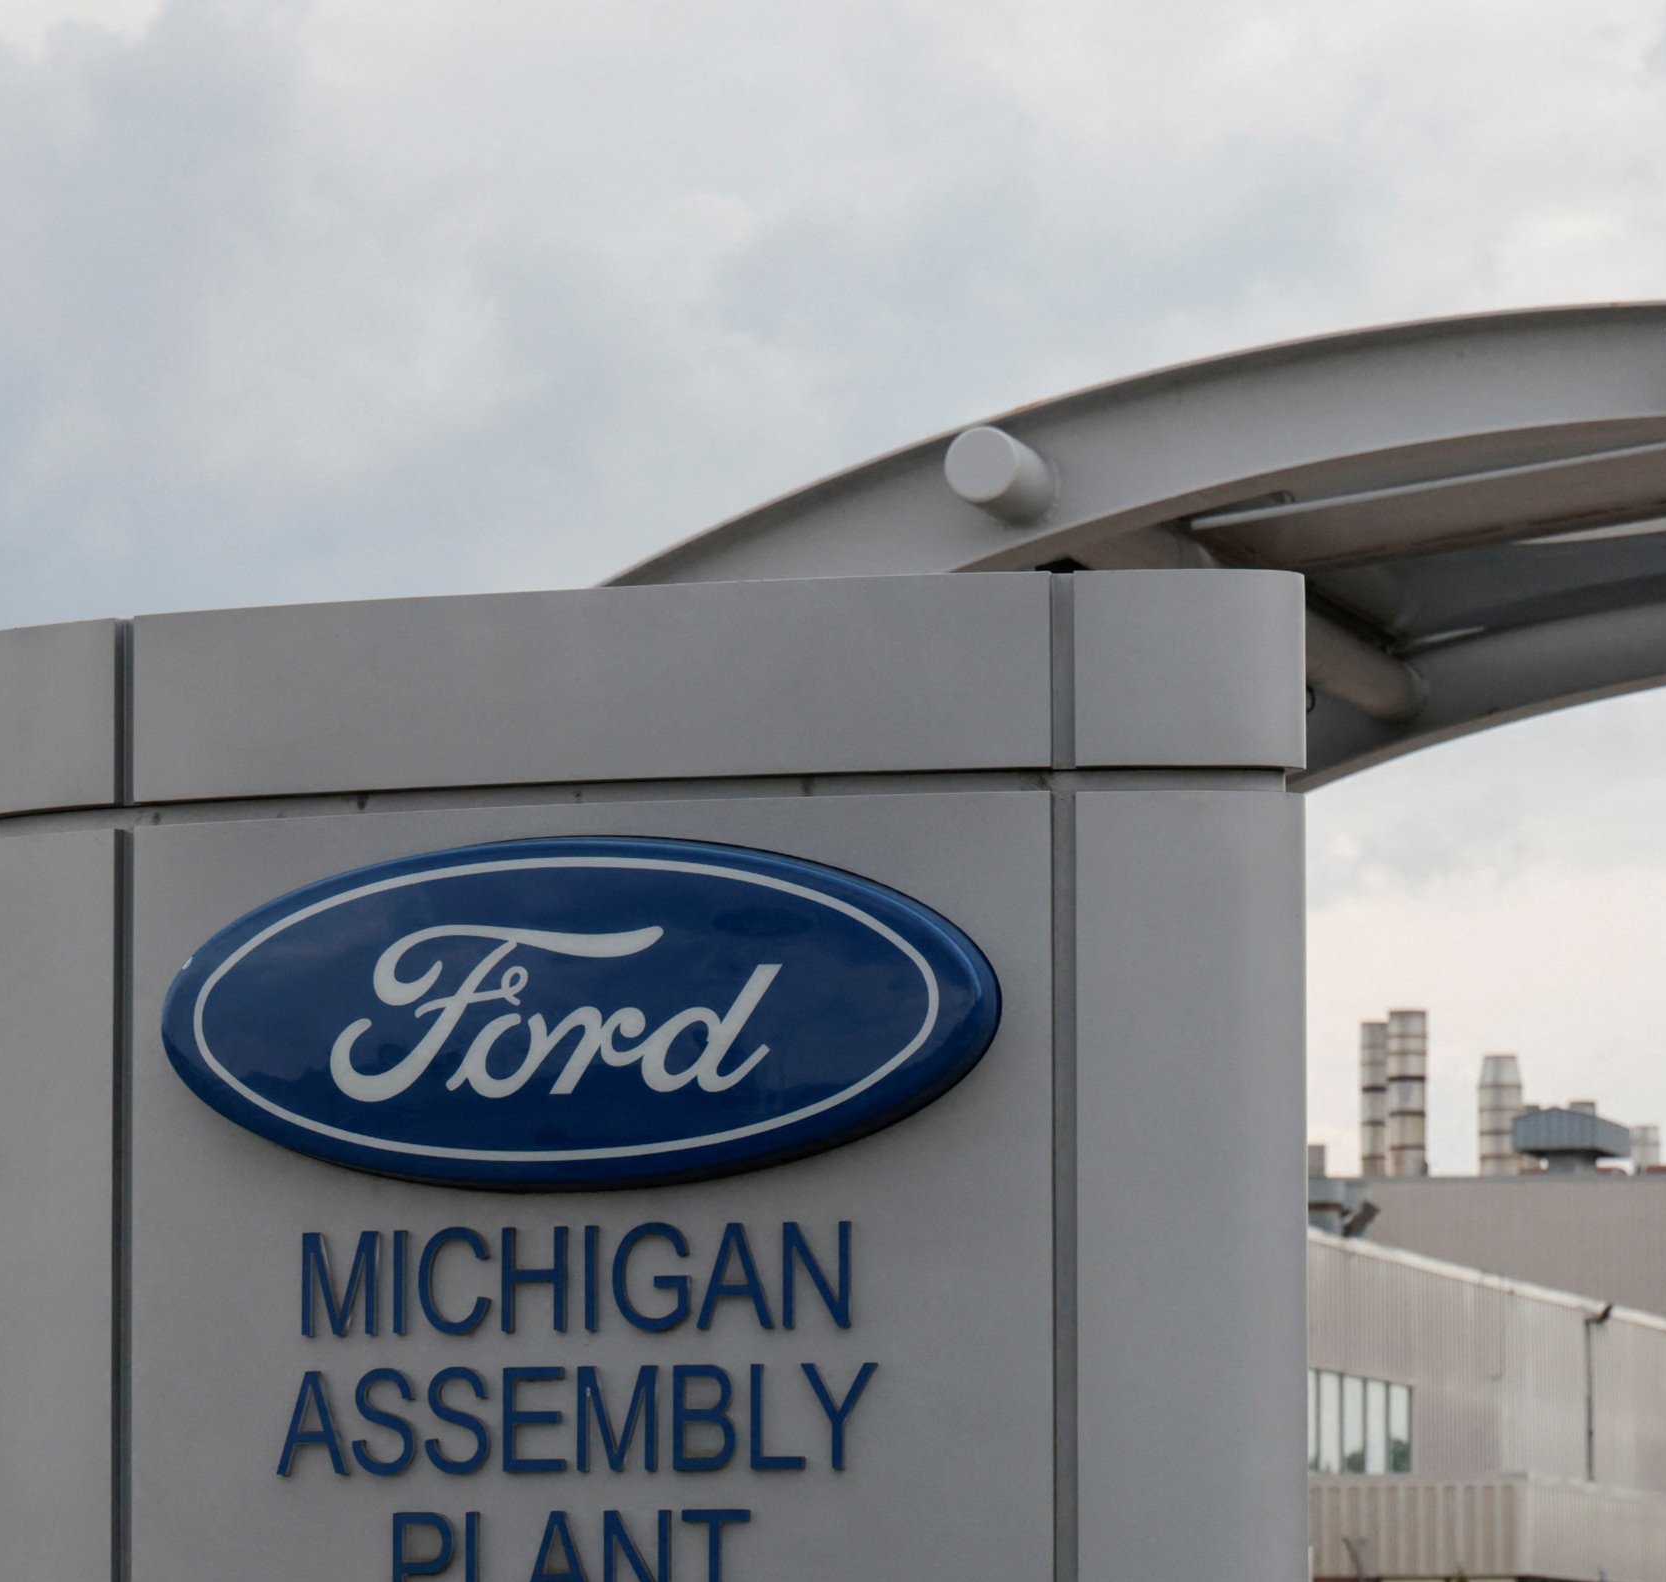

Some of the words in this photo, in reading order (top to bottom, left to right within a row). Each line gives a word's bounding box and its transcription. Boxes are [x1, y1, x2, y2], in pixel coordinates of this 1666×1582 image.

[330, 924, 783, 1102] Ford
[300, 1220, 852, 1337] MICHIGAN
[276, 1362, 877, 1476] ASSEMBLY
